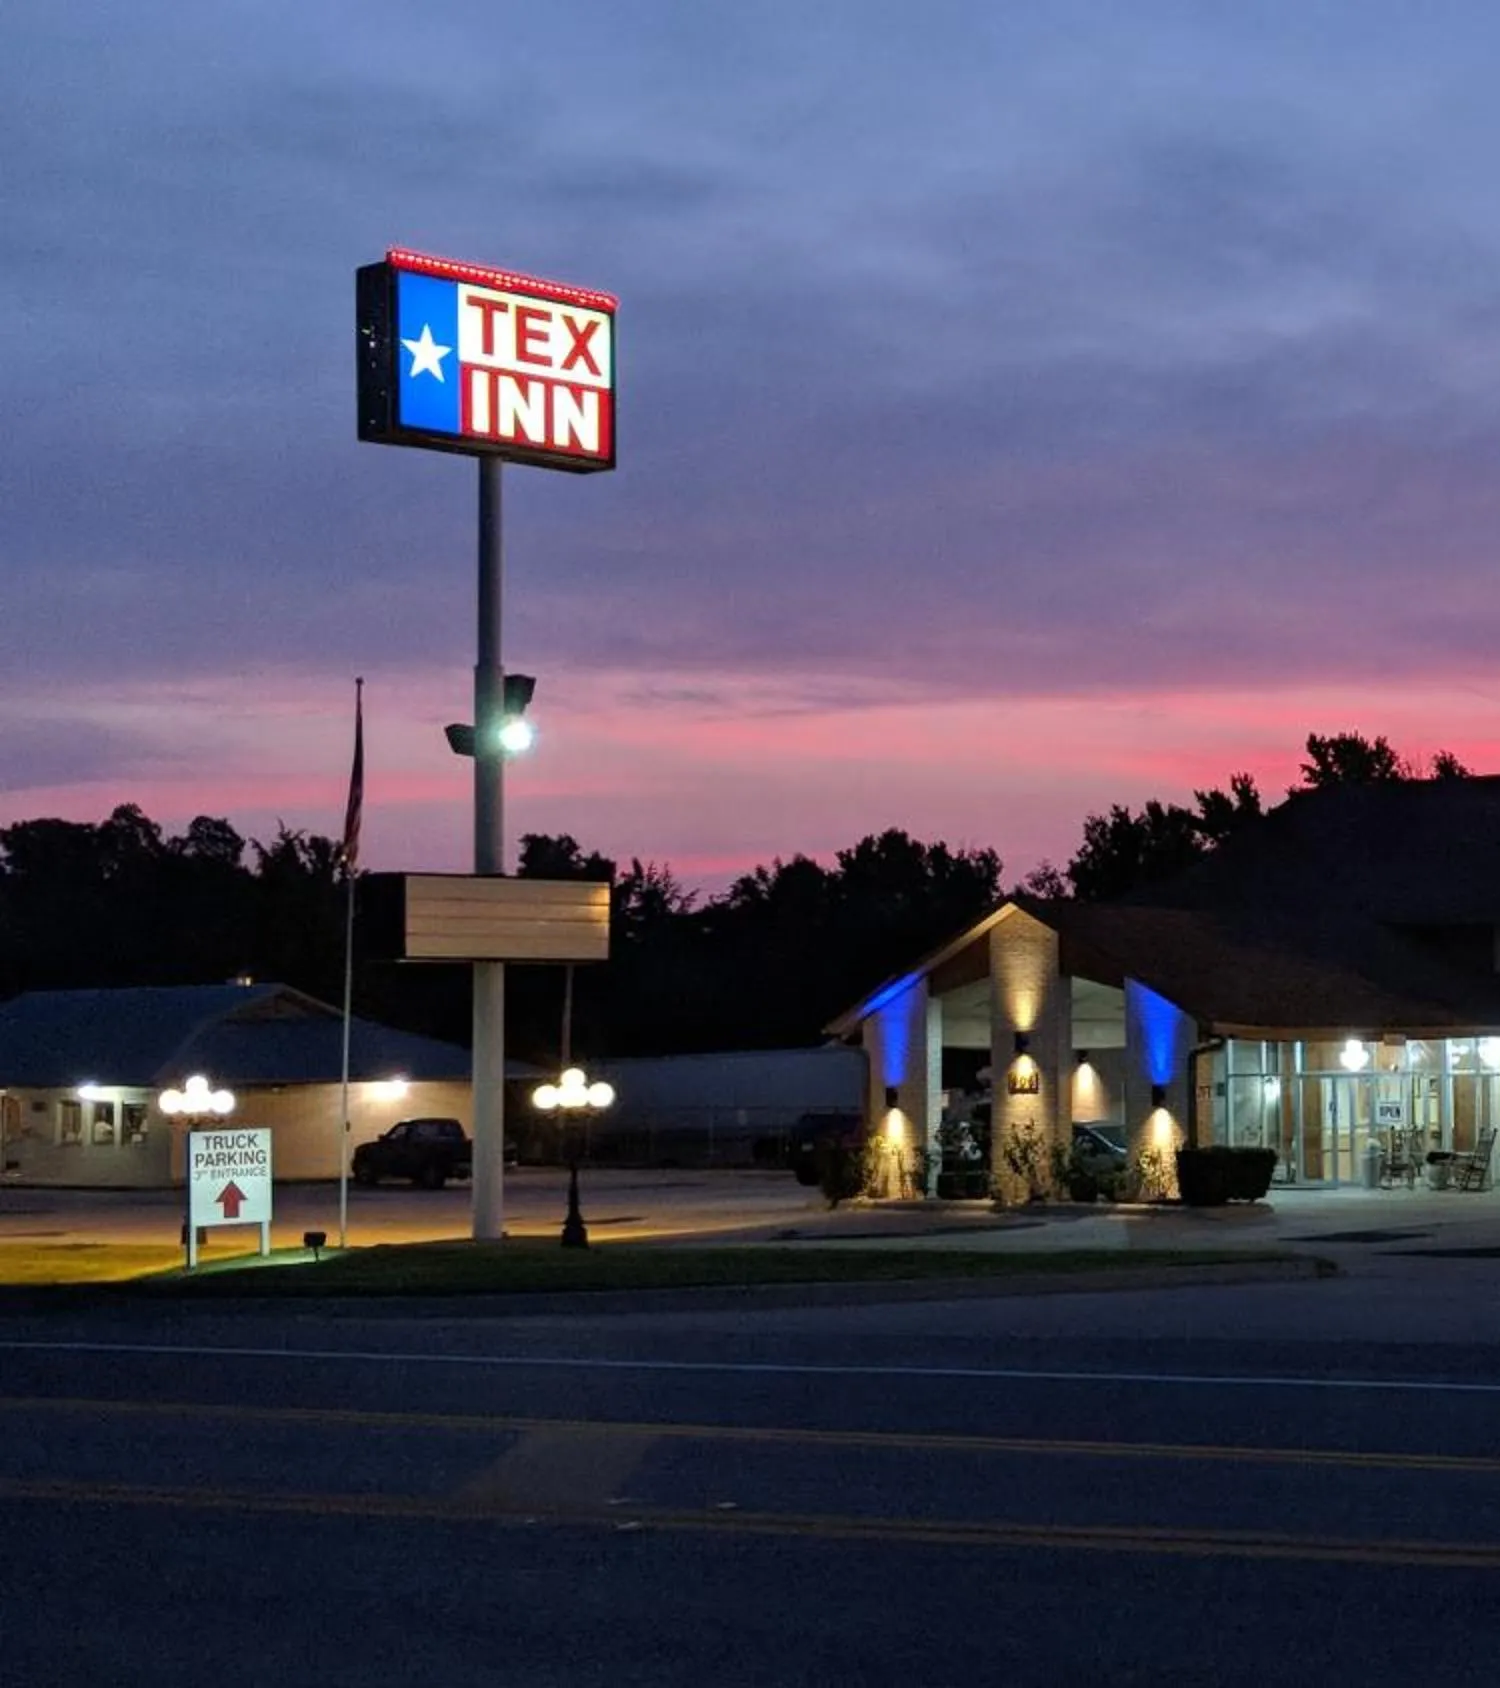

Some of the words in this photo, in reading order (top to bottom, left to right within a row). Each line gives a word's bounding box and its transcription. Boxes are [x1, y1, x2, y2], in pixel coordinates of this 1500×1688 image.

[466, 294, 602, 376] TEX
[471, 369, 599, 452] INN
[203, 1133, 259, 1150] TRUCK
[195, 1150, 267, 1168] PARKING
[210, 1166, 267, 1180] ENTRANCE
